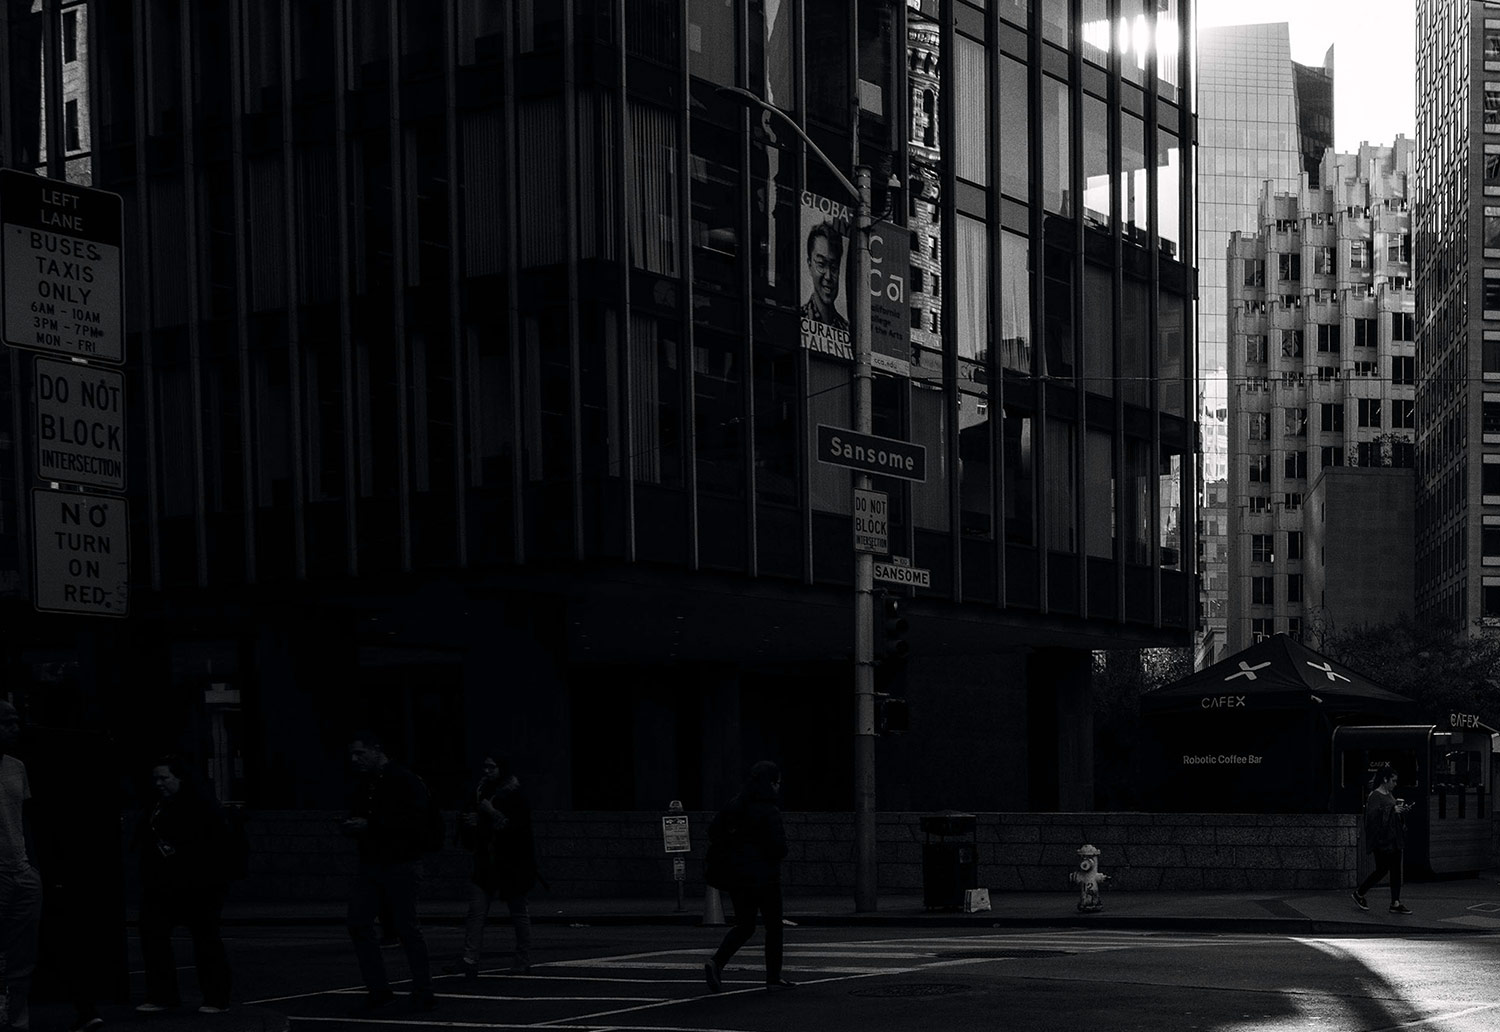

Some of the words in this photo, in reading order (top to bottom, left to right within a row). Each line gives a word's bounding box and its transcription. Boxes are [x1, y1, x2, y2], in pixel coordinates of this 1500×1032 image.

[41, 188, 80, 209] LEFT
[40, 209, 84, 231] LANE
[30, 231, 98, 261] BUSES
[35, 256, 94, 283] TAXIS
[38, 280, 91, 305] ONLY
[31, 301, 55, 315] 6AM
[72, 308, 100, 323] 10AM
[871, 304, 900, 319] alifornia
[33, 316, 58, 330] 3PM
[74, 323, 98, 338] 7PM
[801, 319, 851, 344] CURATED
[36, 332, 61, 346] MON
[78, 340, 96, 353] FRI
[801, 332, 852, 359] TALENT
[40, 373, 69, 403] DO
[81, 381, 120, 412] NOT
[41, 413, 121, 452] BLOCK
[42, 449, 121, 478] INTERSECTION
[830, 436, 914, 471] Sansome
[61, 502, 107, 528] NO
[855, 497, 867, 512] DO
[870, 499, 887, 515] NOT
[855, 518, 887, 535] BLOCK
[54, 531, 110, 554] TURN
[856, 535, 887, 548] INTERSECTION
[68, 559, 100, 579] ON
[875, 565, 928, 585] SANSOME
[1201, 695, 1246, 709] CAFEX
[1183, 754, 1217, 765] Robotic
[1218, 754, 1247, 764] Coffee
[1248, 754, 1263, 764] Bar
